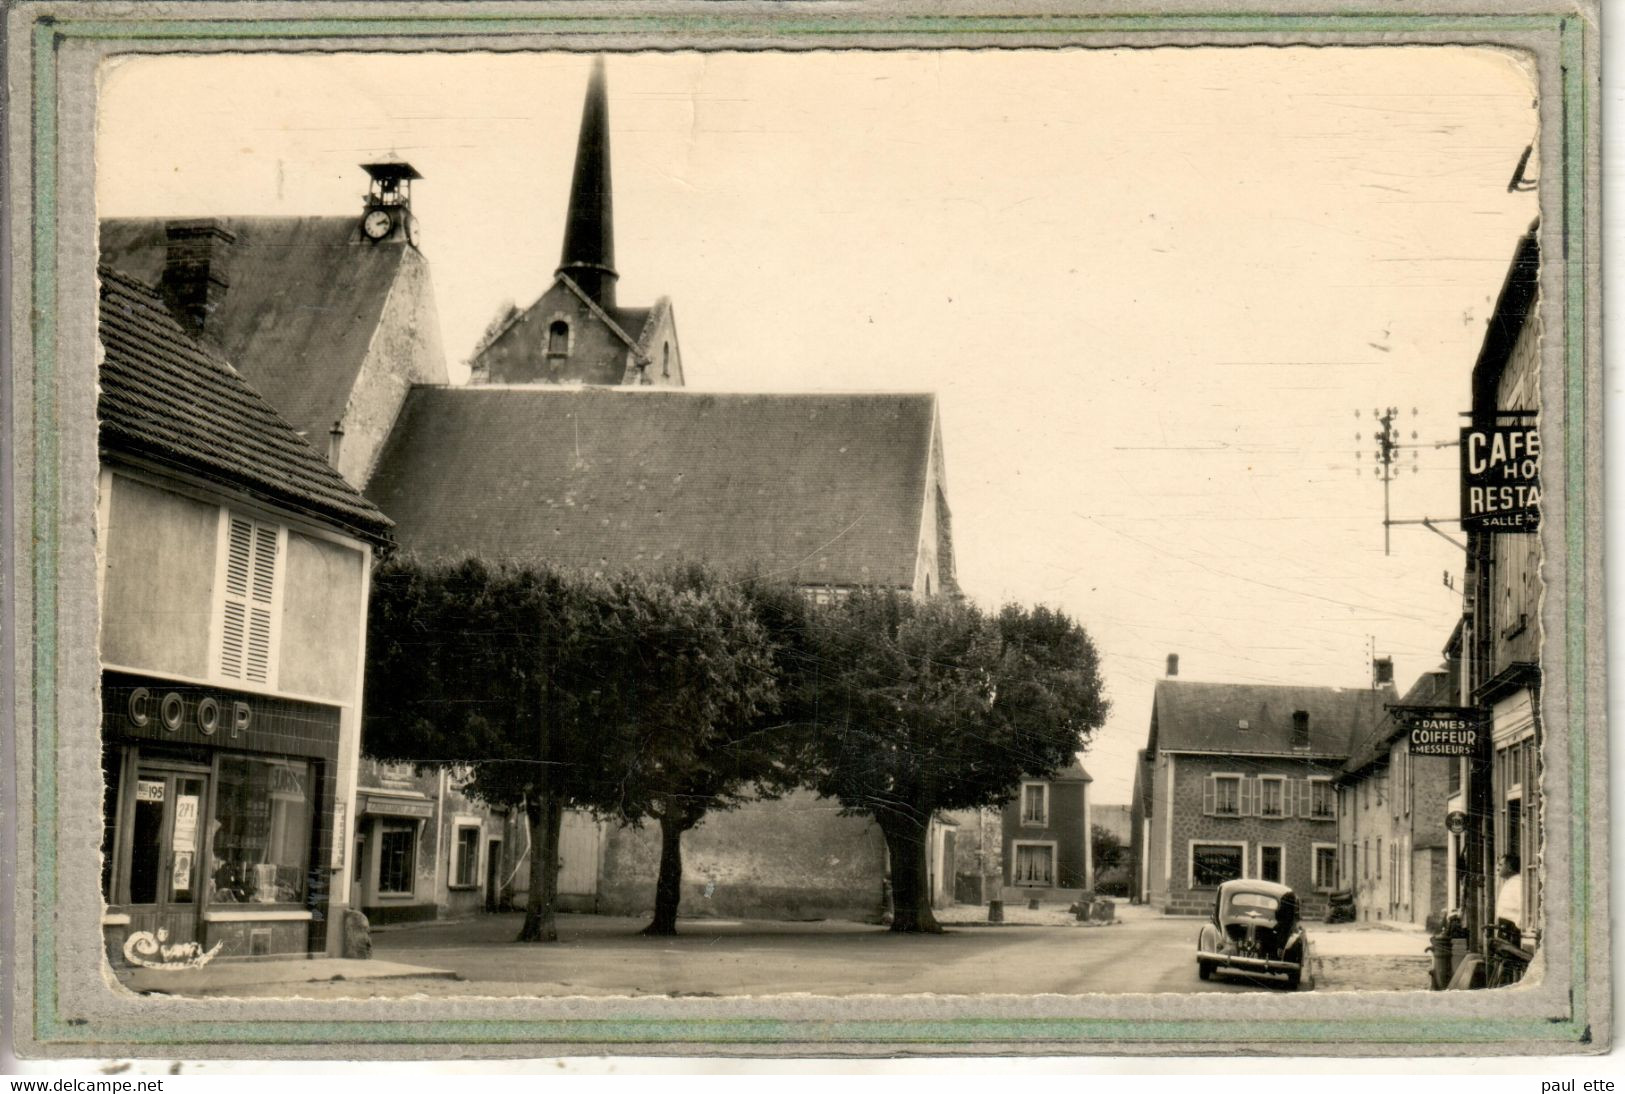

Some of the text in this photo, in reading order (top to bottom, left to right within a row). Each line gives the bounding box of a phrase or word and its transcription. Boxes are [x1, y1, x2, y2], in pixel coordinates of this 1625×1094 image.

[1470, 485, 1541, 514] RESTA
[1482, 514, 1523, 526] SALLE
[128, 686, 252, 739] COOP
[1422, 720, 1466, 730] DAMES
[1411, 728, 1477, 746] COIFFEUR
[1415, 744, 1471, 755] MESSIEURS
[148, 785, 163, 798] 195
